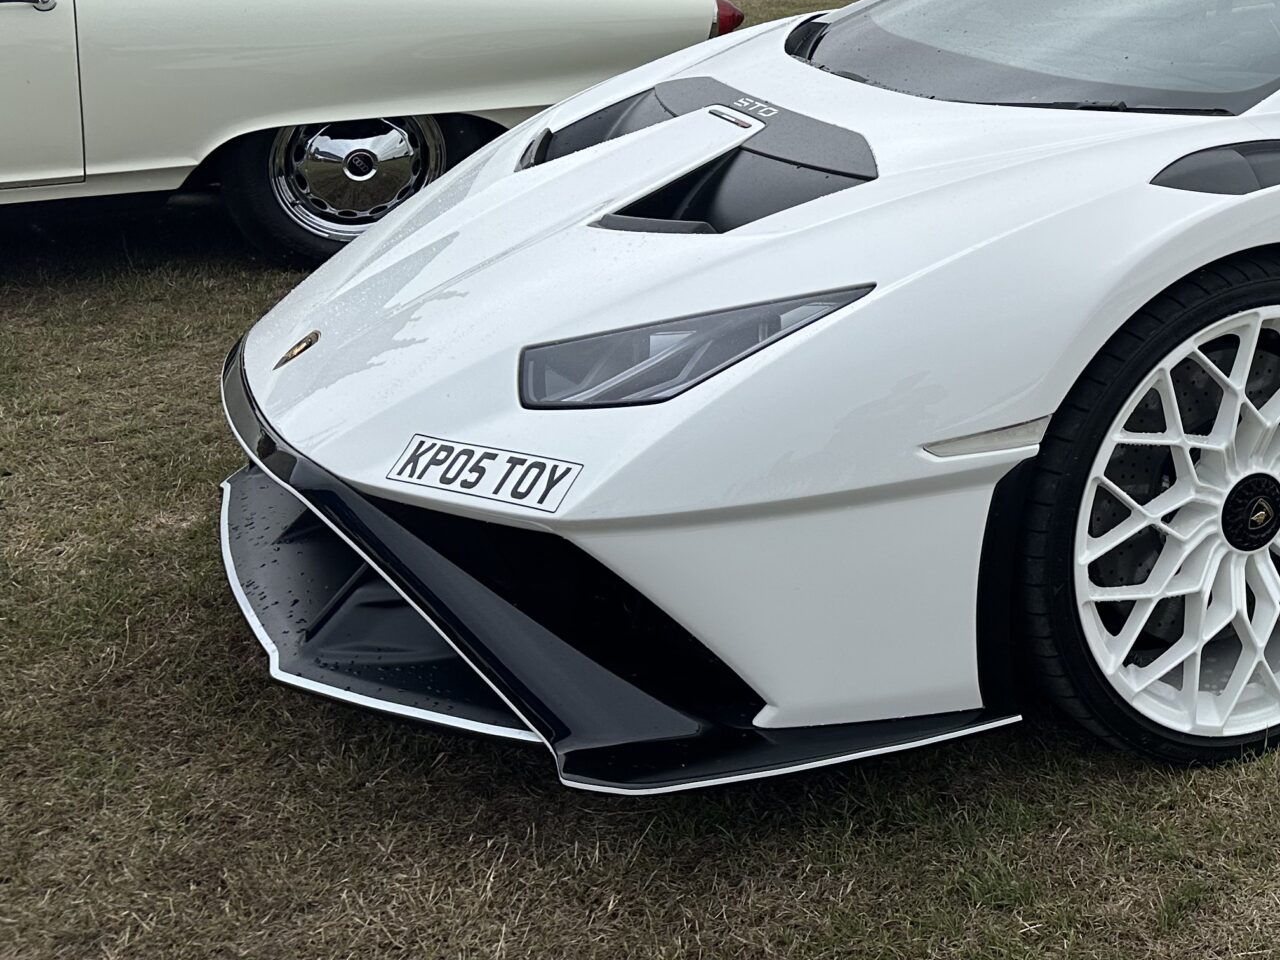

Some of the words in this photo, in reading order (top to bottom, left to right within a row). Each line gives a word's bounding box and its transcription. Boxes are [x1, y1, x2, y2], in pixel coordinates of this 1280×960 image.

[733, 98, 778, 116] STO
[396, 440, 498, 489] KP05
[492, 456, 572, 505] TOY
